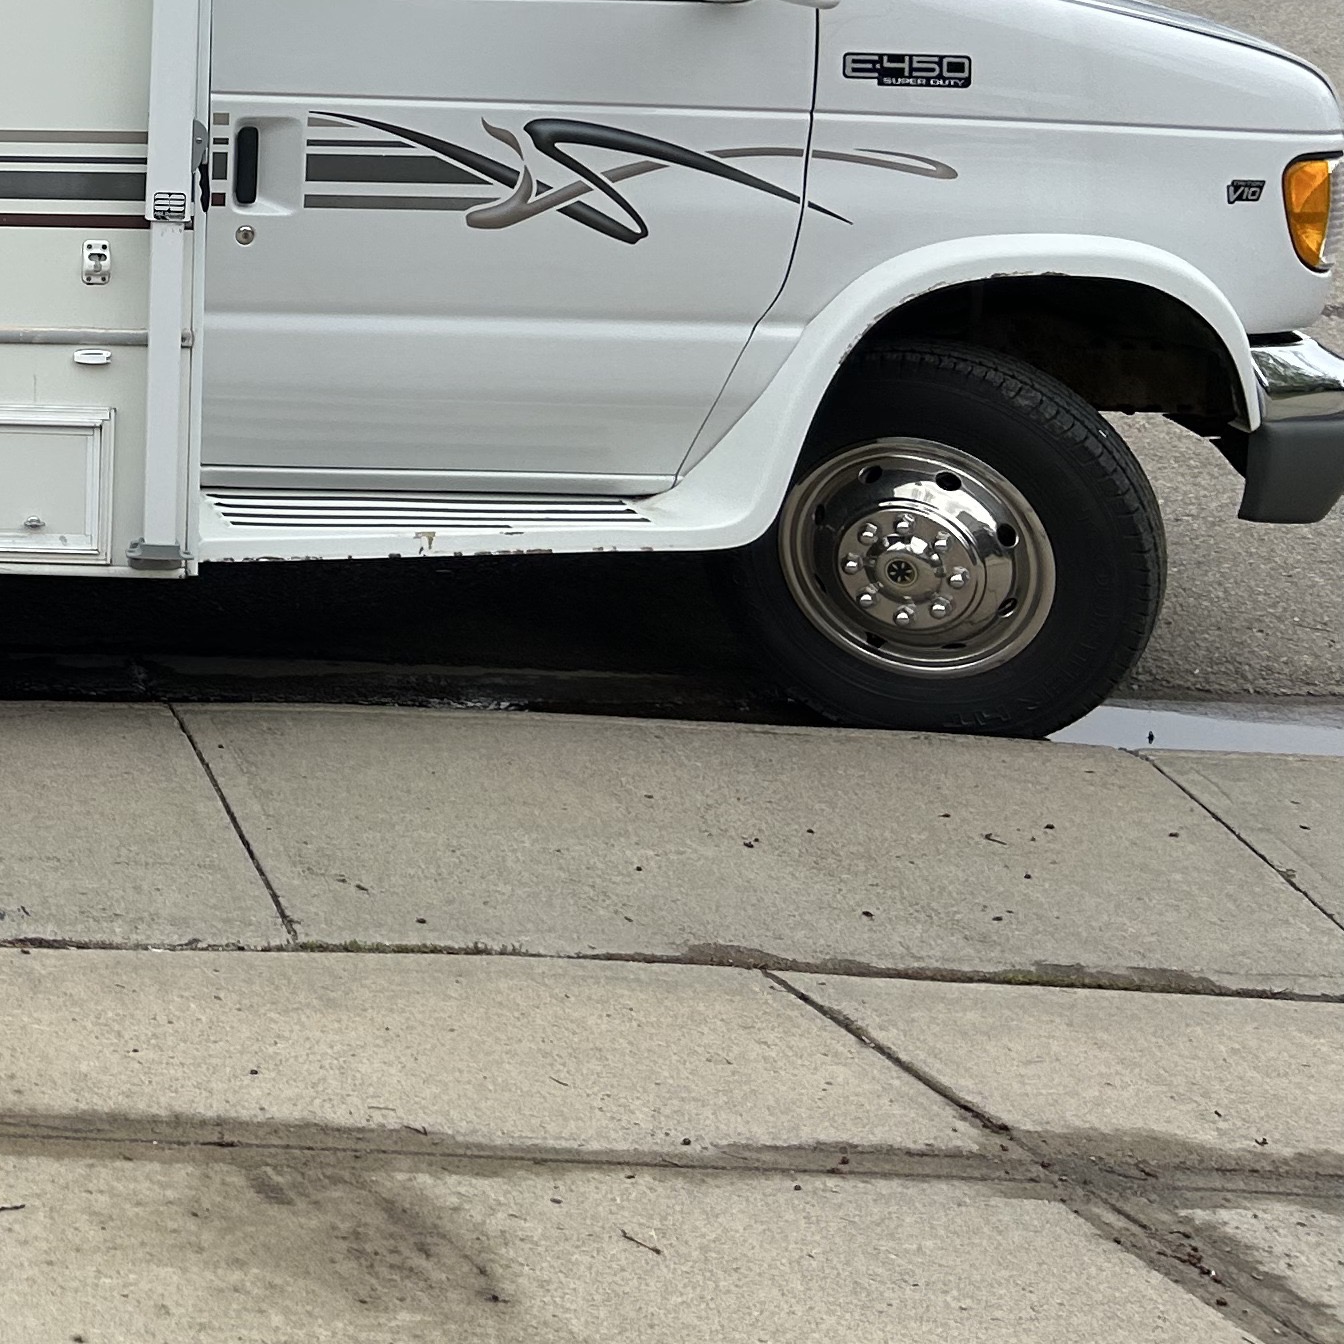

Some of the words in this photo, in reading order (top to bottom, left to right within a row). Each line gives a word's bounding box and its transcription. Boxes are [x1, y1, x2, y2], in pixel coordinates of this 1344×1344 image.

[883, 76, 926, 86] SUPER
[929, 78, 966, 87] DUTY
[1228, 186, 1260, 202] V10
